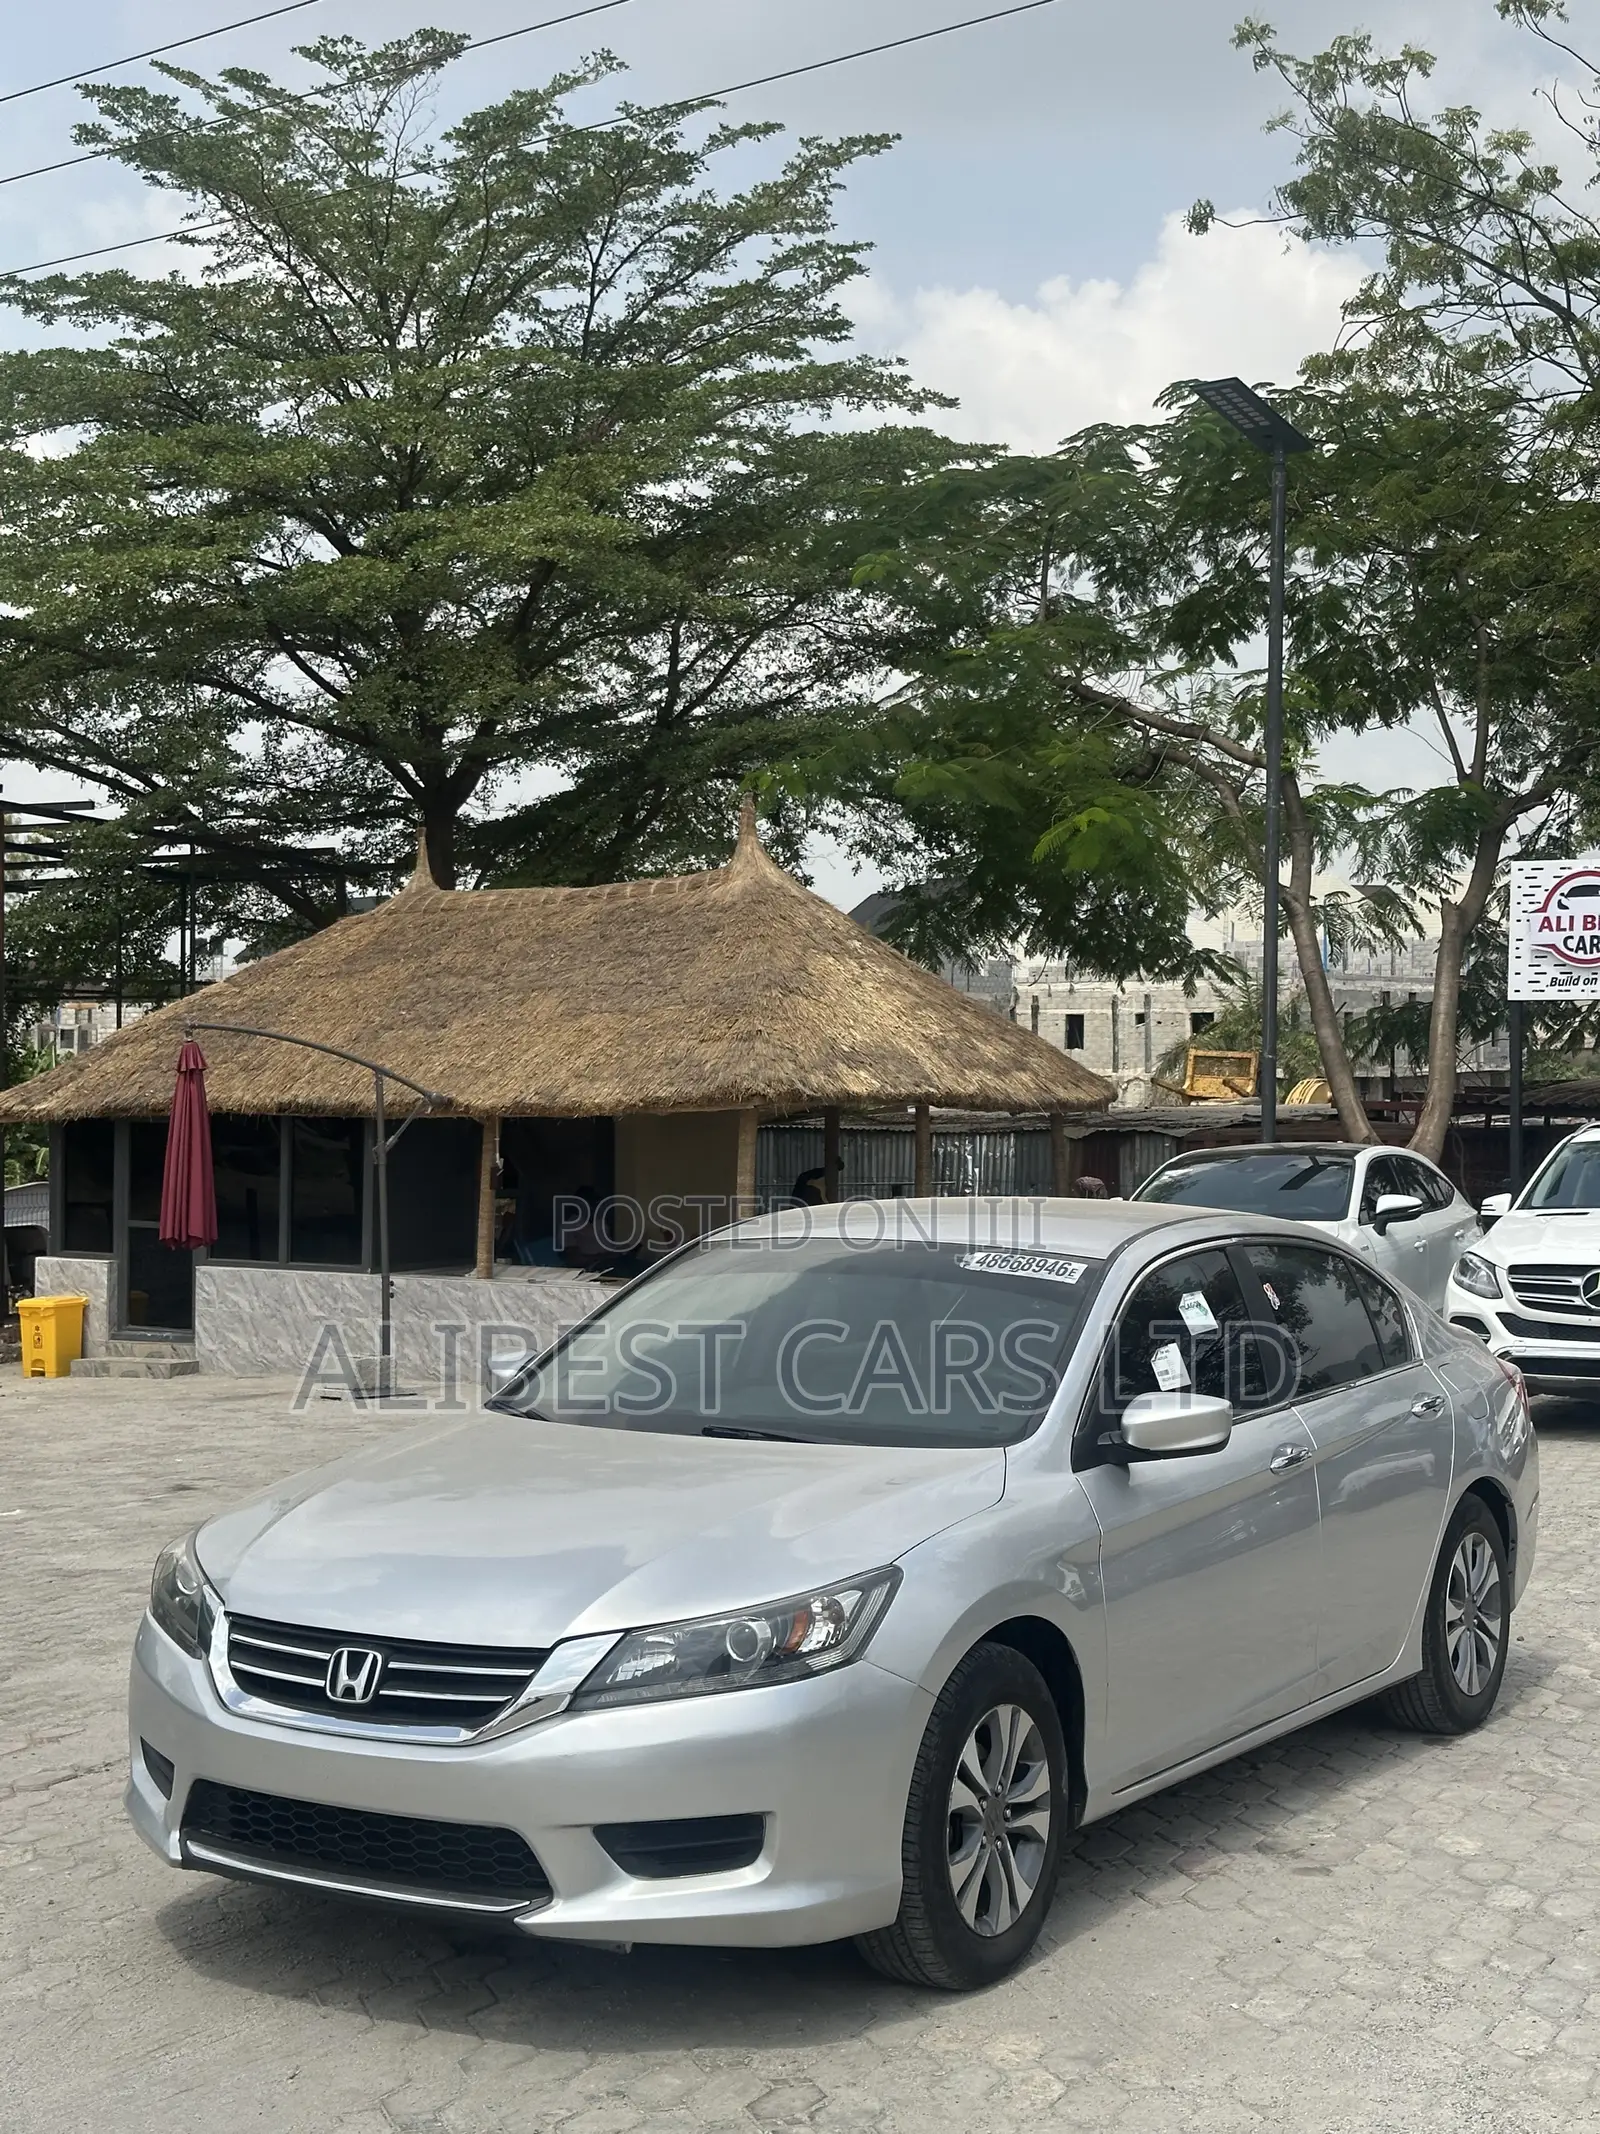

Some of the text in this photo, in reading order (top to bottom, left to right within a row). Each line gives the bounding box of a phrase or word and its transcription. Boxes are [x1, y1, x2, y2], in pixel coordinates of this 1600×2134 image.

[1538, 914, 1600, 932] ALI B
[1562, 935, 1600, 955] CAR
[1582, 977, 1598, 986] on
